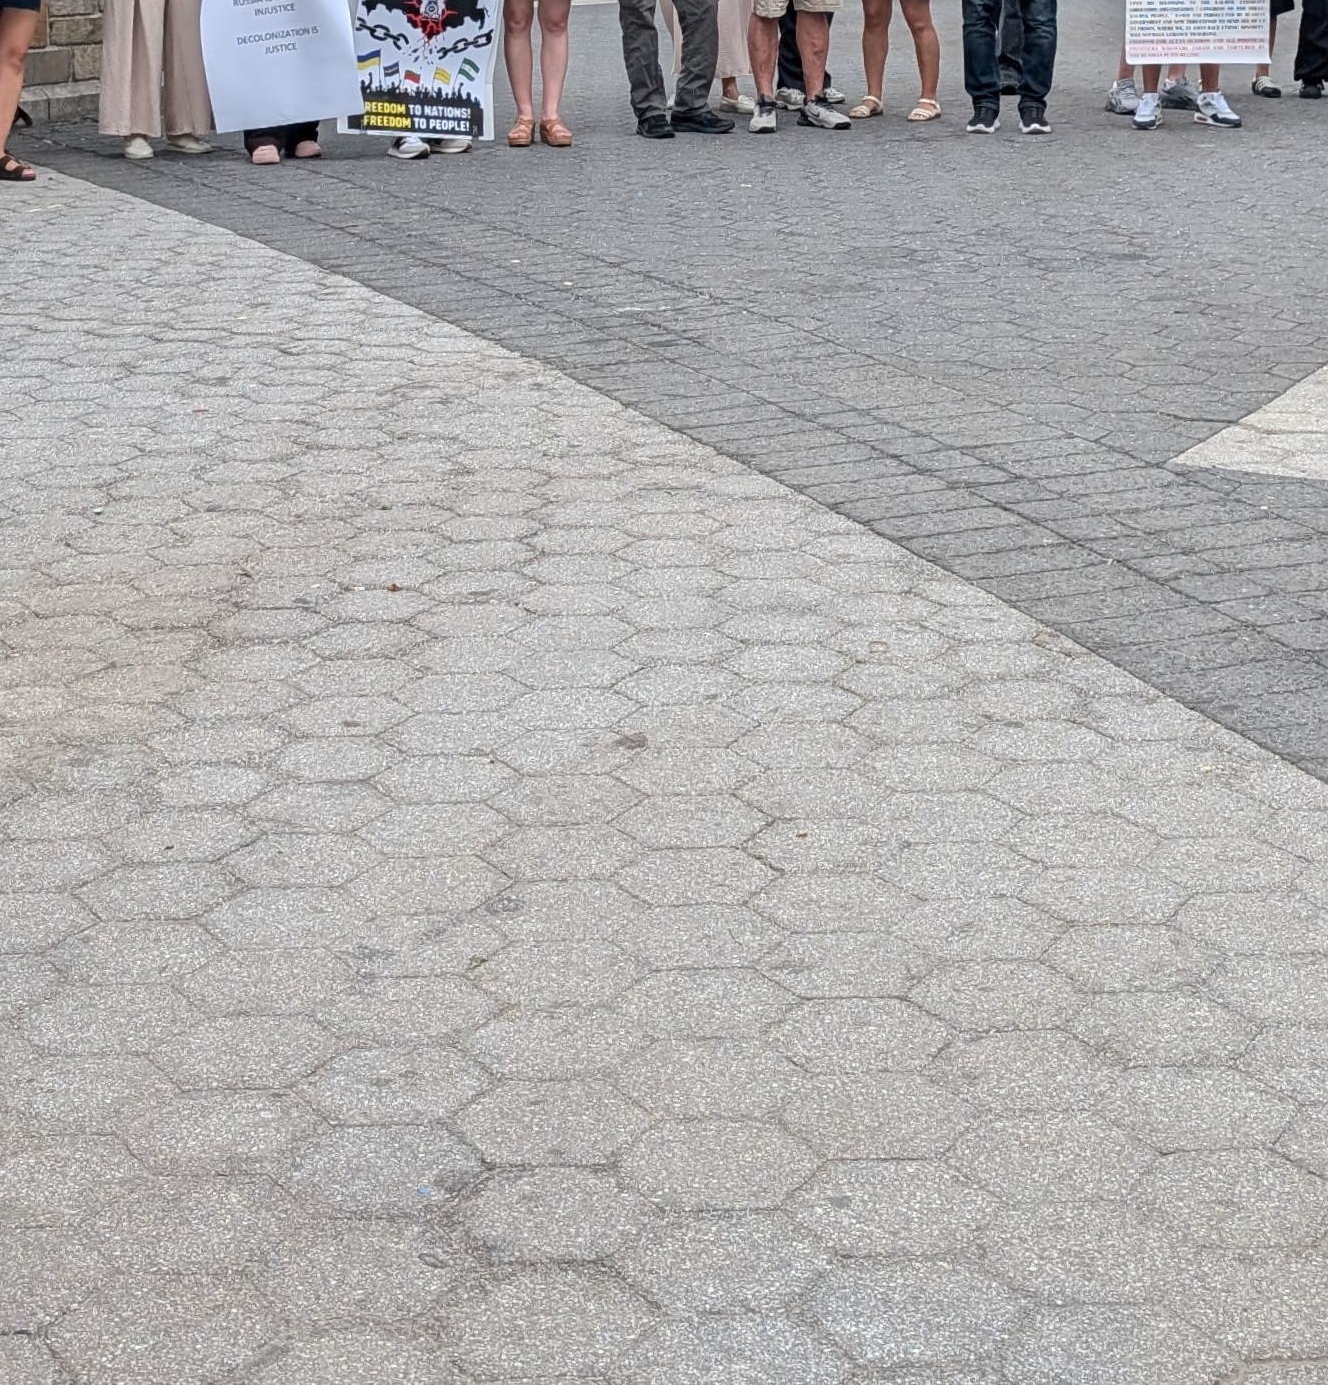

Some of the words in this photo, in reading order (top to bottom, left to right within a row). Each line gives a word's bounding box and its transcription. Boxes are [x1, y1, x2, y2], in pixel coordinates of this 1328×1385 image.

[254, 3, 296, 16] INJUSTICE
[237, 26, 311, 46] DECOLONIZATION
[311, 25, 319, 35] IS
[265, 42, 298, 55] JUSTICE
[364, 100, 406, 114] REEDOM
[408, 104, 422, 115] TO
[424, 104, 471, 119] NATIONS!
[363, 115, 411, 129] FREEDOM
[413, 117, 427, 129] TO
[429, 118, 470, 132] PEOPLE!
